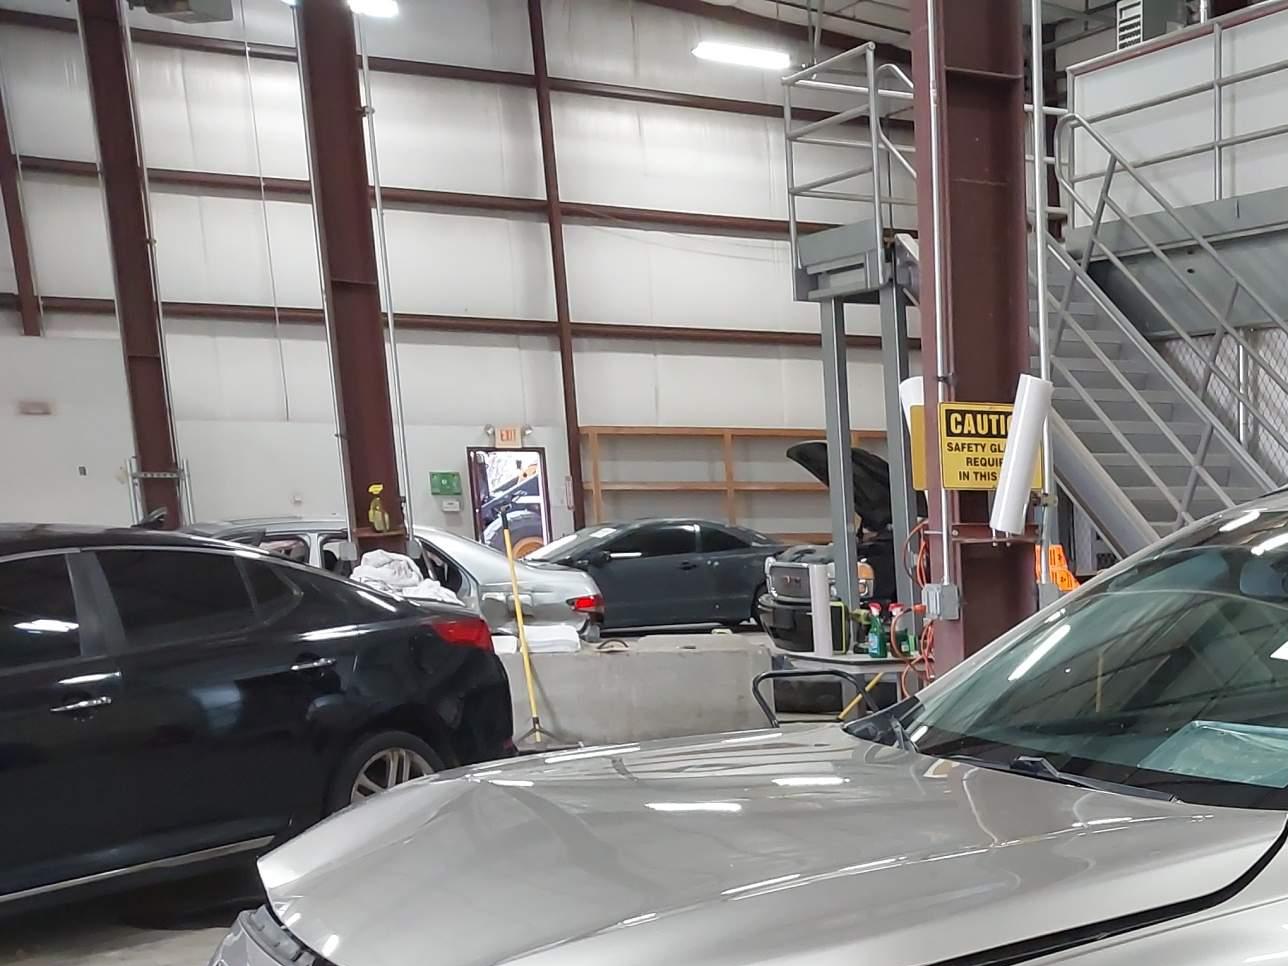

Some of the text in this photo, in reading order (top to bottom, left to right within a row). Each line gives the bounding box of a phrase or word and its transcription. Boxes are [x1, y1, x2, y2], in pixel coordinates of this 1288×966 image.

[950, 412, 1012, 436] CAUTI
[946, 442, 987, 453] SAFETY
[966, 457, 1004, 468] REQUI
[959, 471, 998, 482] IN THIS
